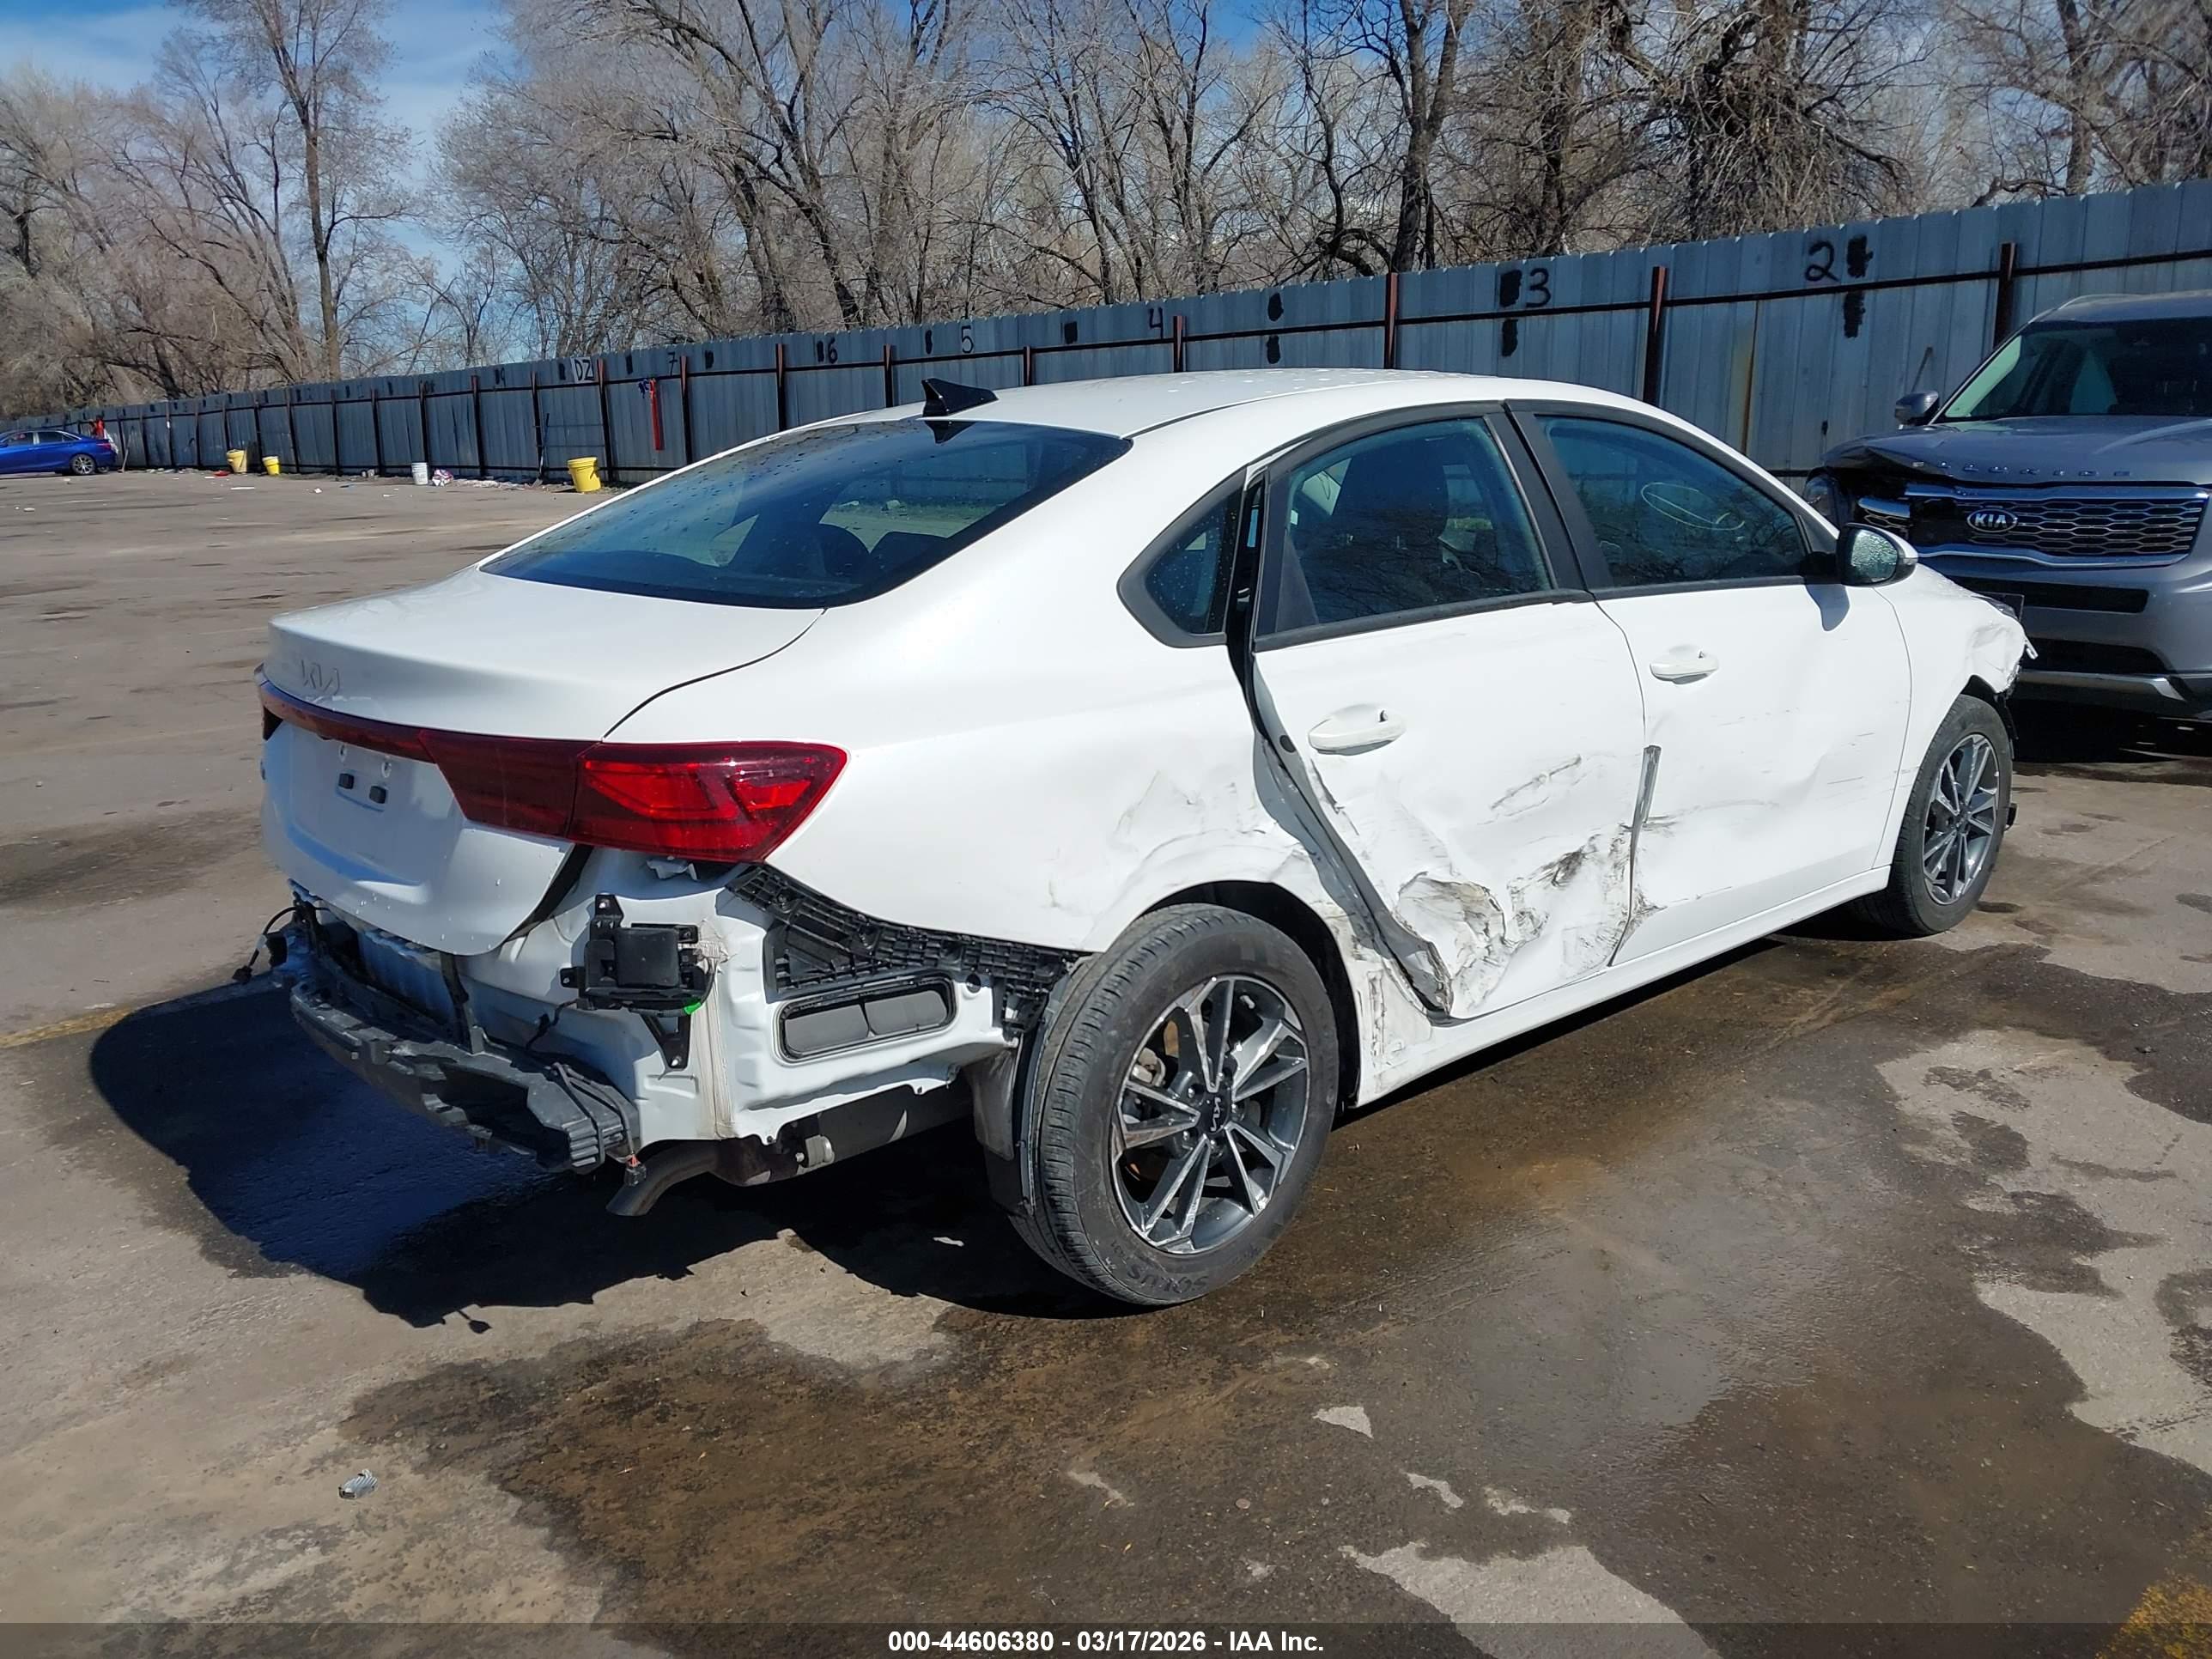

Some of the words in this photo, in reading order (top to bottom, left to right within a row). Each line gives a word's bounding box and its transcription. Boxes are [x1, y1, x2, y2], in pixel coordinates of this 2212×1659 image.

[1805, 241, 1839, 281] 2
[1149, 307, 1164, 340] 4
[961, 325, 974, 353] 5
[1975, 514, 2007, 527] KIA
